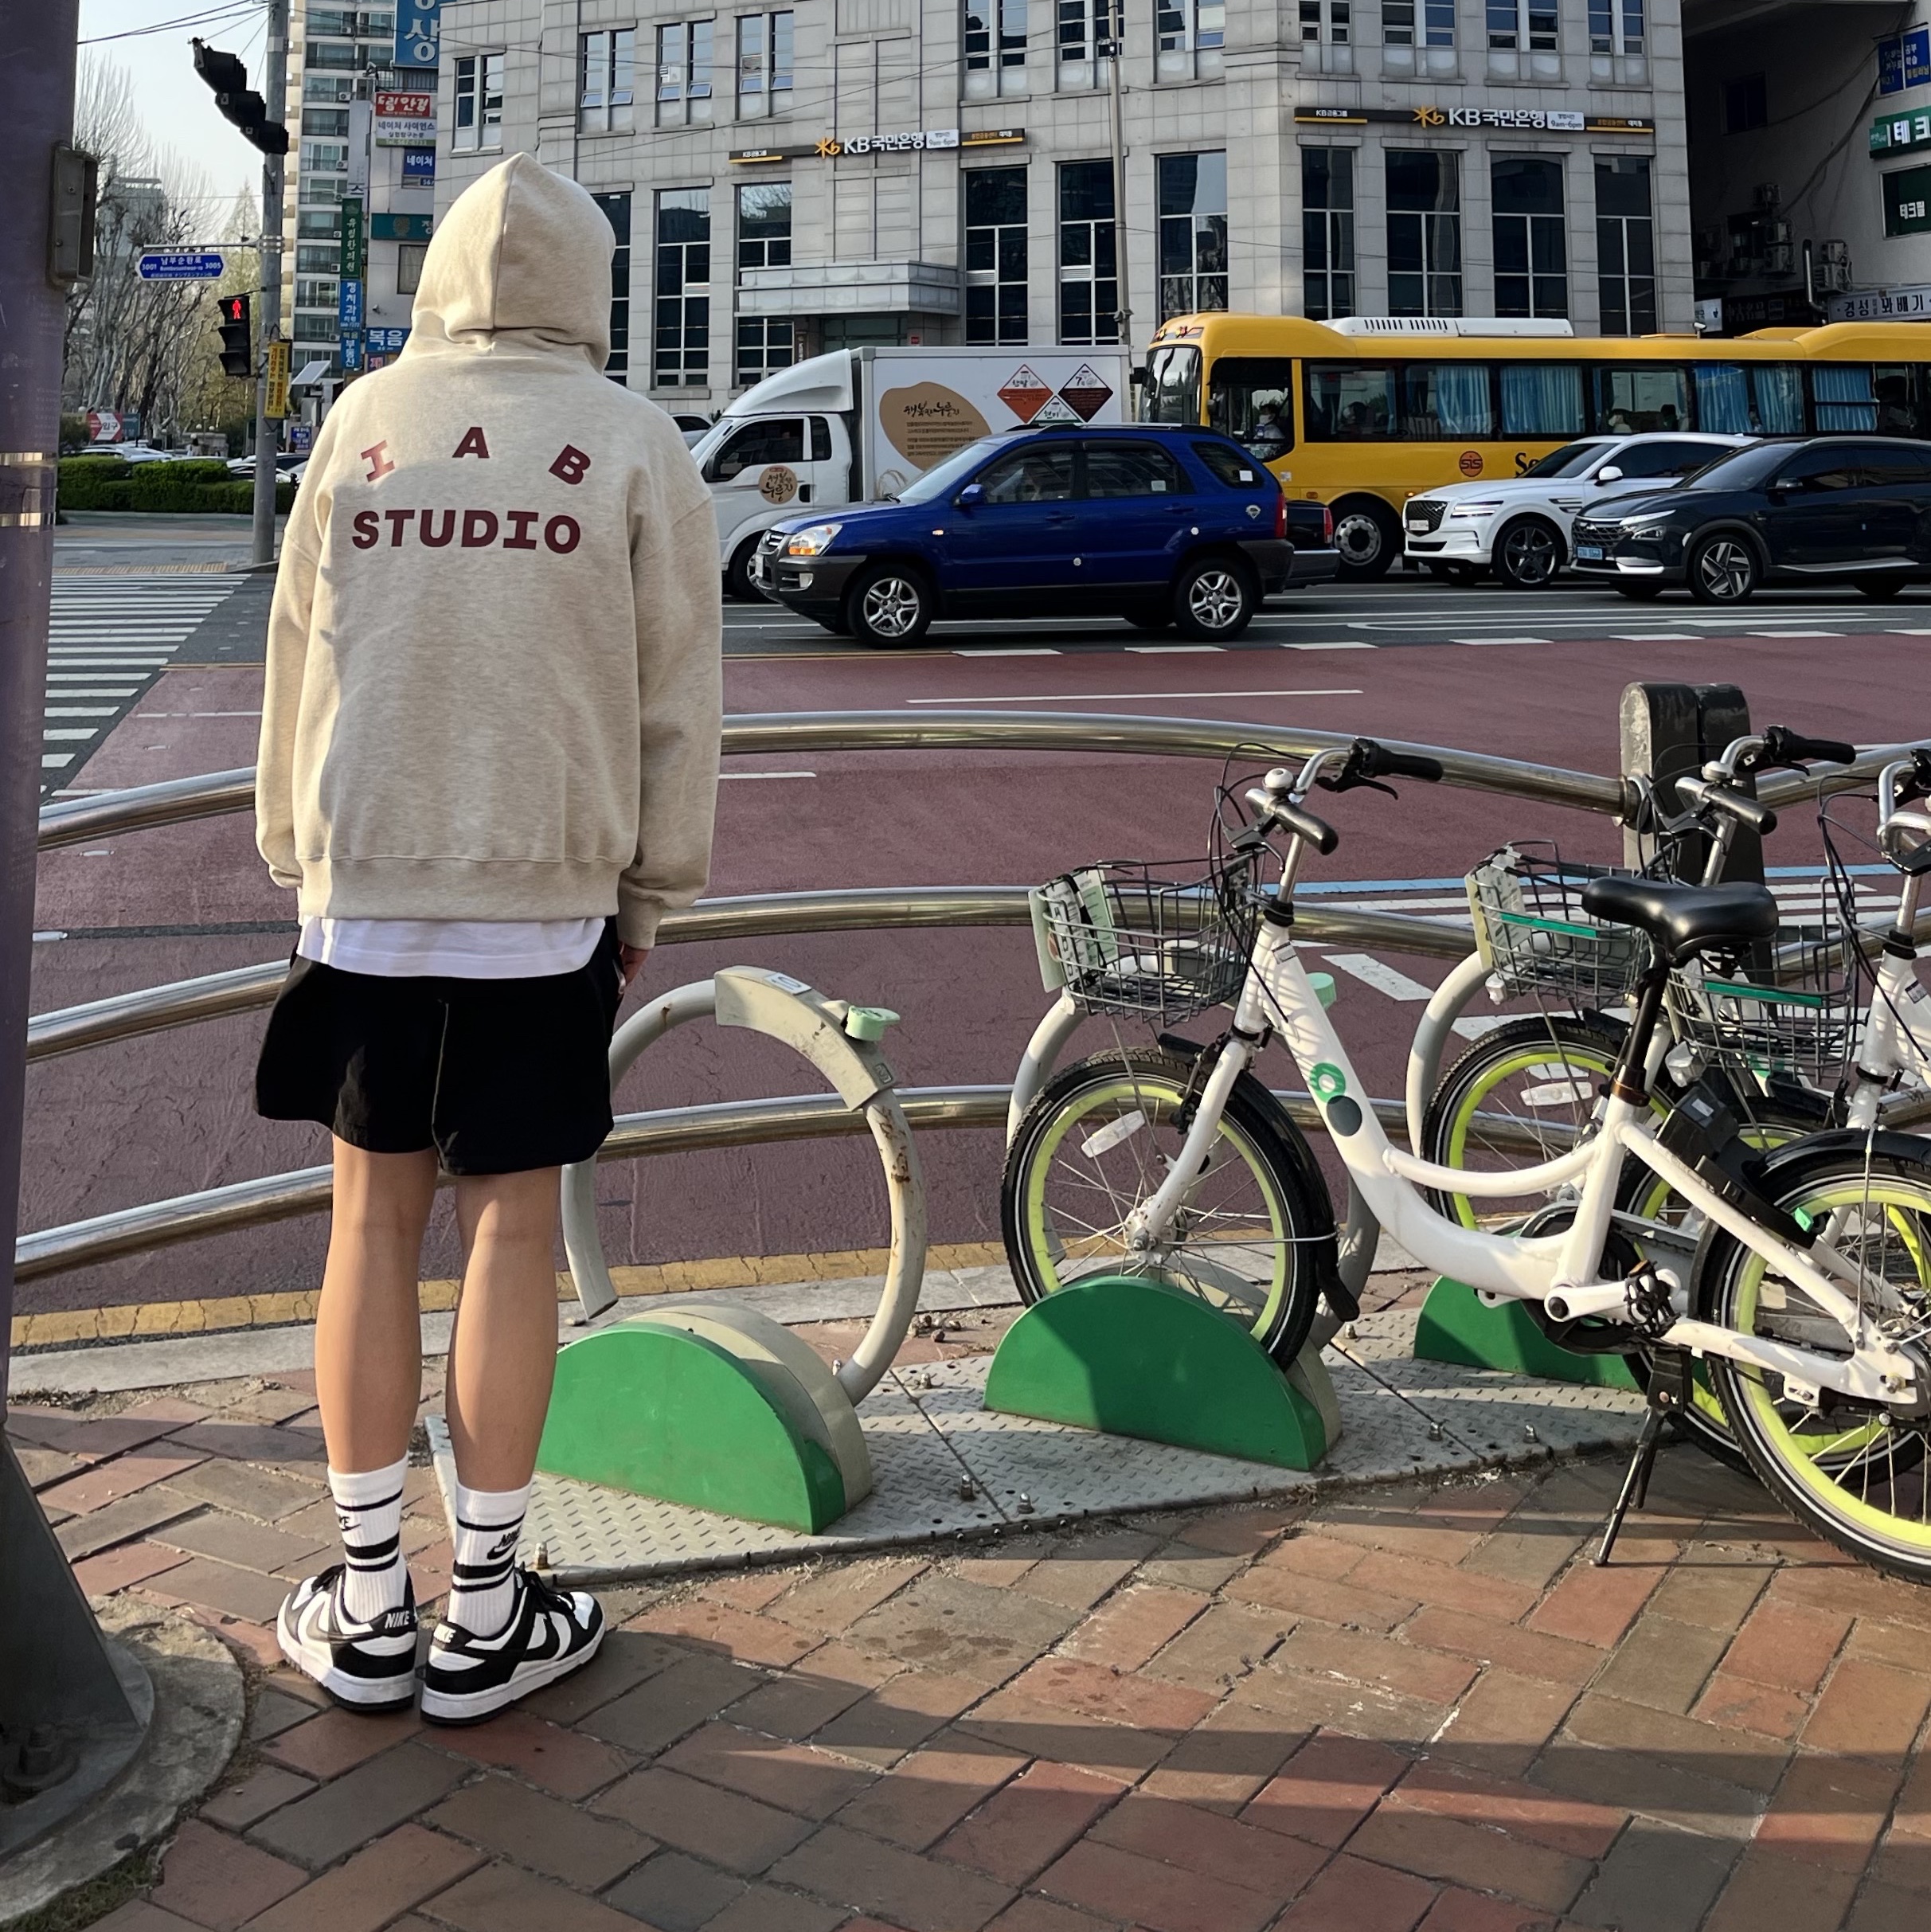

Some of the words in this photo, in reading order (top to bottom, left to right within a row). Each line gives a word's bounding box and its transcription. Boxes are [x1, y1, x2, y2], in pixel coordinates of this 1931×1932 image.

[378, 121, 401, 131] 네이처
[404, 121, 436, 131] 사이언스
[407, 155, 433, 166] 네이처
[161, 256, 202, 265] 남부순환로
[1843, 299, 1870, 318] 경성
[368, 330, 403, 346] 복음
[352, 509, 581, 554] STUDIO
[385, 1610, 410, 1629] NIKE
